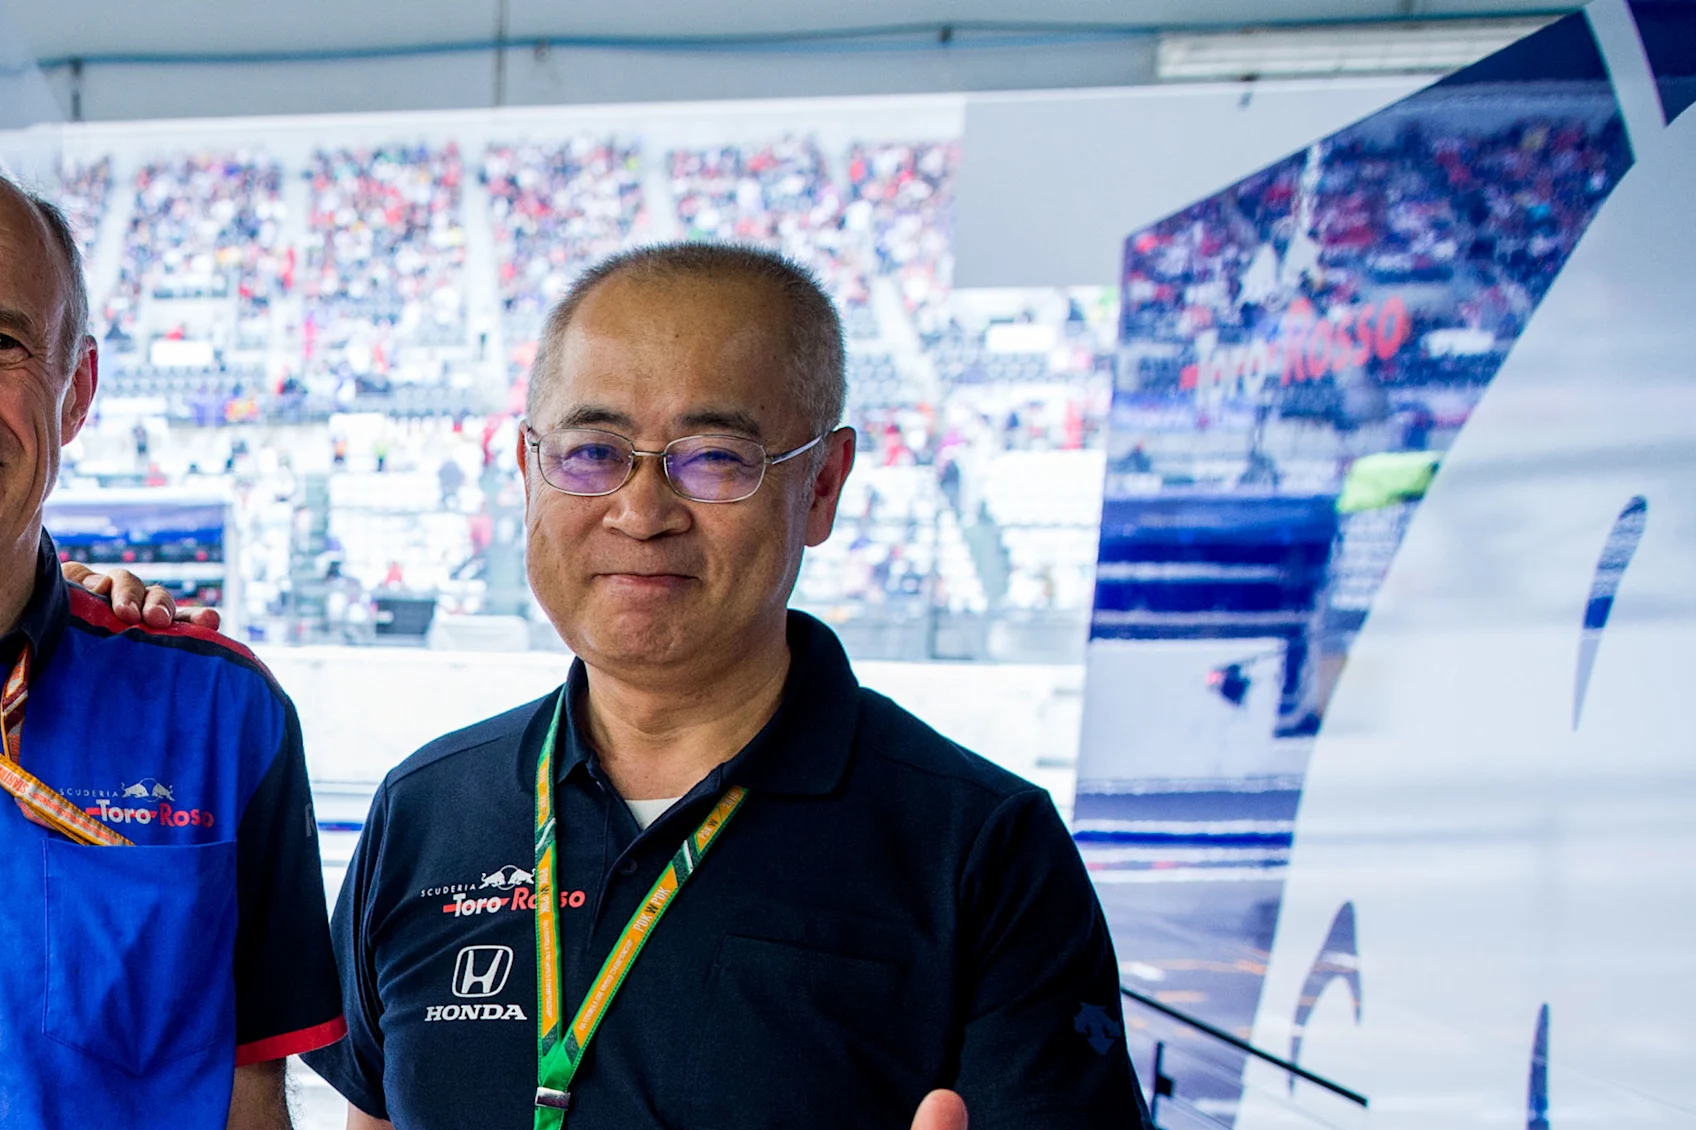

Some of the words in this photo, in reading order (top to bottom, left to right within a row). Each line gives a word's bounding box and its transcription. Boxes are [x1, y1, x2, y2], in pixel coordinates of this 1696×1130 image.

[1281, 296, 1411, 387] Rosso
[59, 788, 118, 797] SCUDERIA
[96, 799, 151, 824] Toro
[421, 884, 476, 897] SCUDERIA
[453, 893, 502, 917] Toro
[425, 1004, 527, 1022] HONDA
